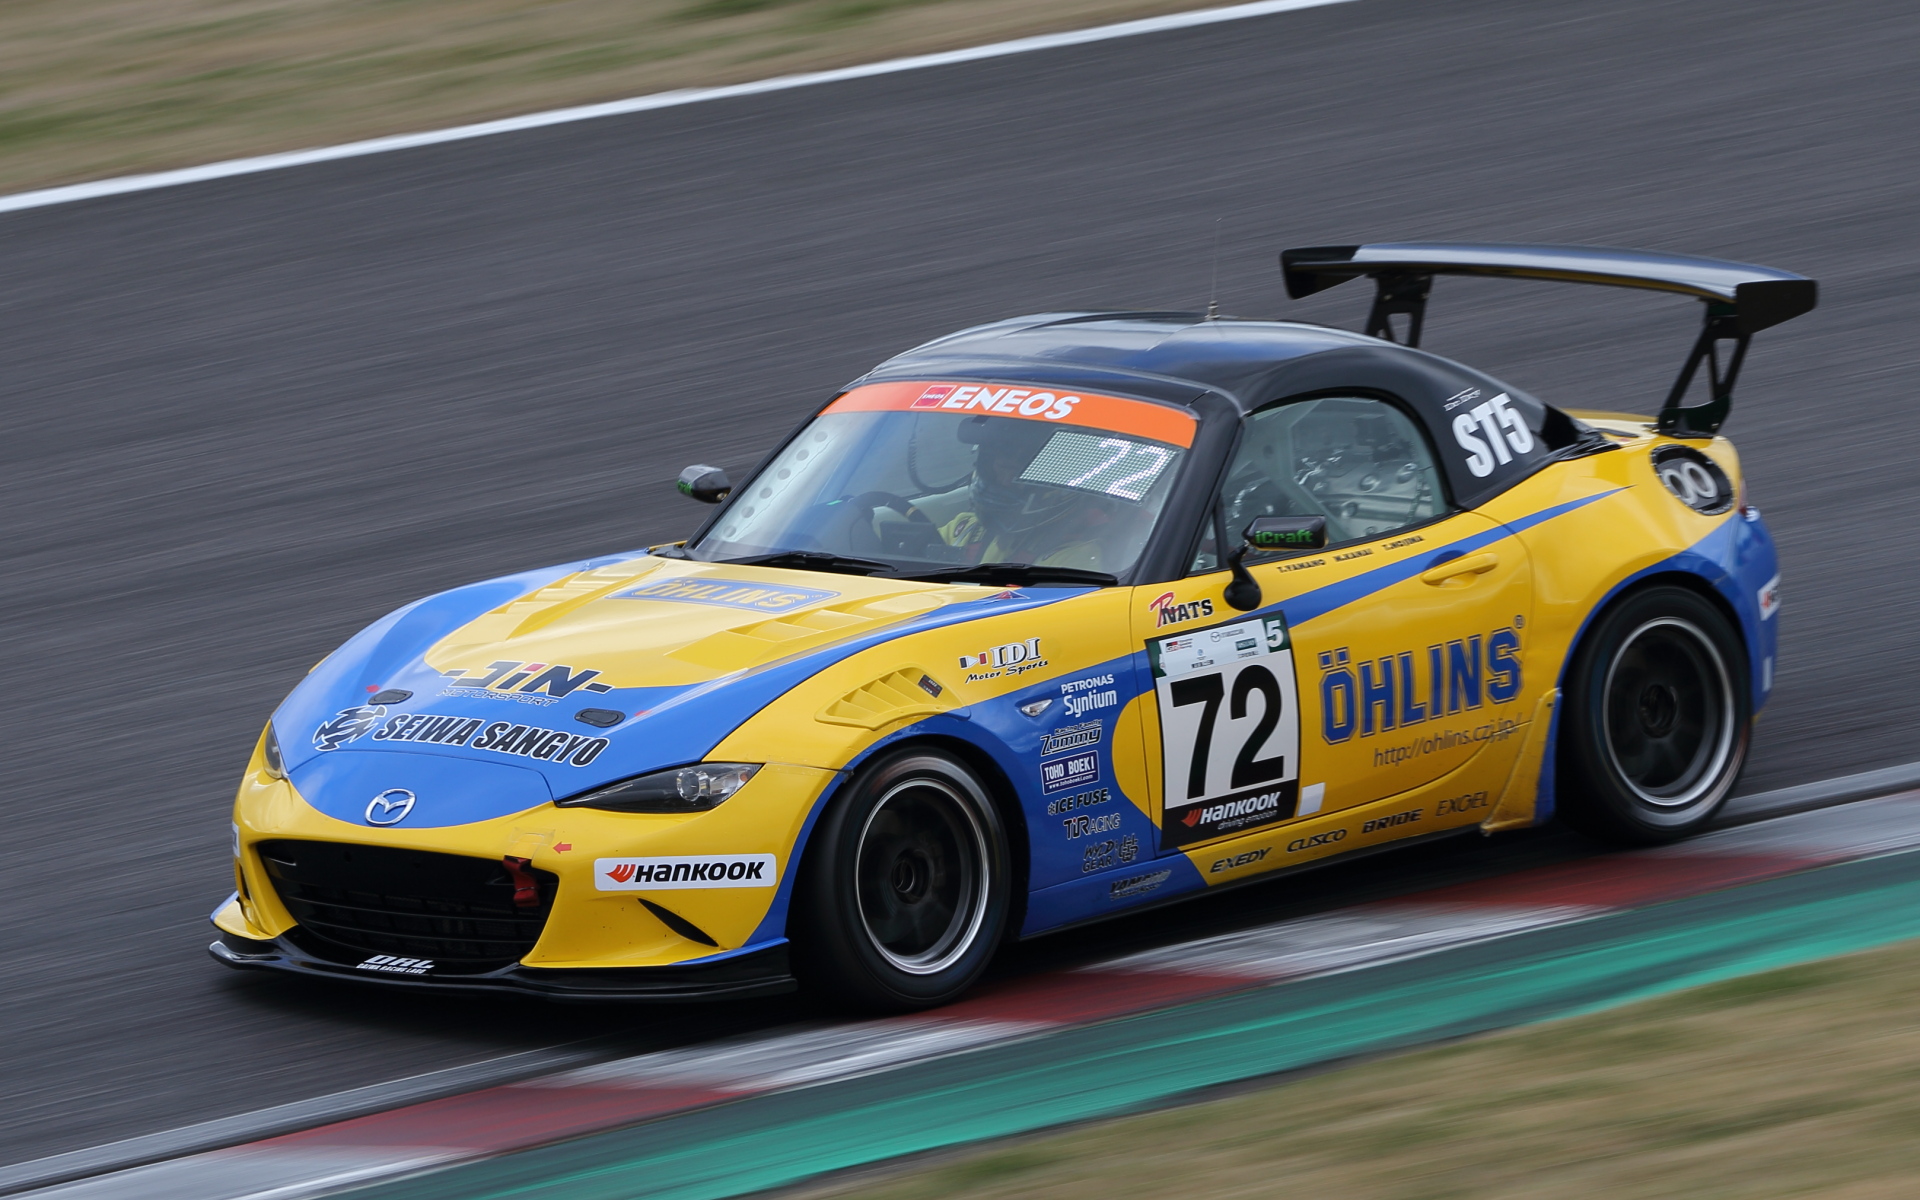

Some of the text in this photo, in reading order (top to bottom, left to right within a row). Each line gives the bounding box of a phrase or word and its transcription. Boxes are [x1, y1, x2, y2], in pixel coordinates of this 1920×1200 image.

[941, 386, 1081, 420] ENEOS
[1452, 392, 1535, 478] ST5
[1067, 437, 1170, 501] 72
[1255, 529, 1314, 544] iCraft
[1266, 620, 1284, 648] 5
[990, 637, 1041, 668] IDI
[965, 659, 1049, 684] Motor Sports
[1061, 673, 1115, 694] PETRONAS
[1318, 626, 1524, 745] ÖHLINS
[436, 688, 559, 707] MOTORSPORT
[1063, 689, 1118, 718] Syntium
[375, 713, 610, 768] SEIWA SANGYO
[1040, 725, 1102, 757] Zummy
[1170, 664, 1285, 800] 72
[1044, 756, 1095, 781] TOHO BOEKI
[1054, 787, 1109, 814] ICE FUSE
[1217, 809, 1278, 830] driving emotion
[1209, 846, 1272, 873] EXEDY
[1286, 828, 1348, 853] CUSCO
[1361, 808, 1424, 834] BRIDE
[1082, 855, 1112, 873] GEAR
